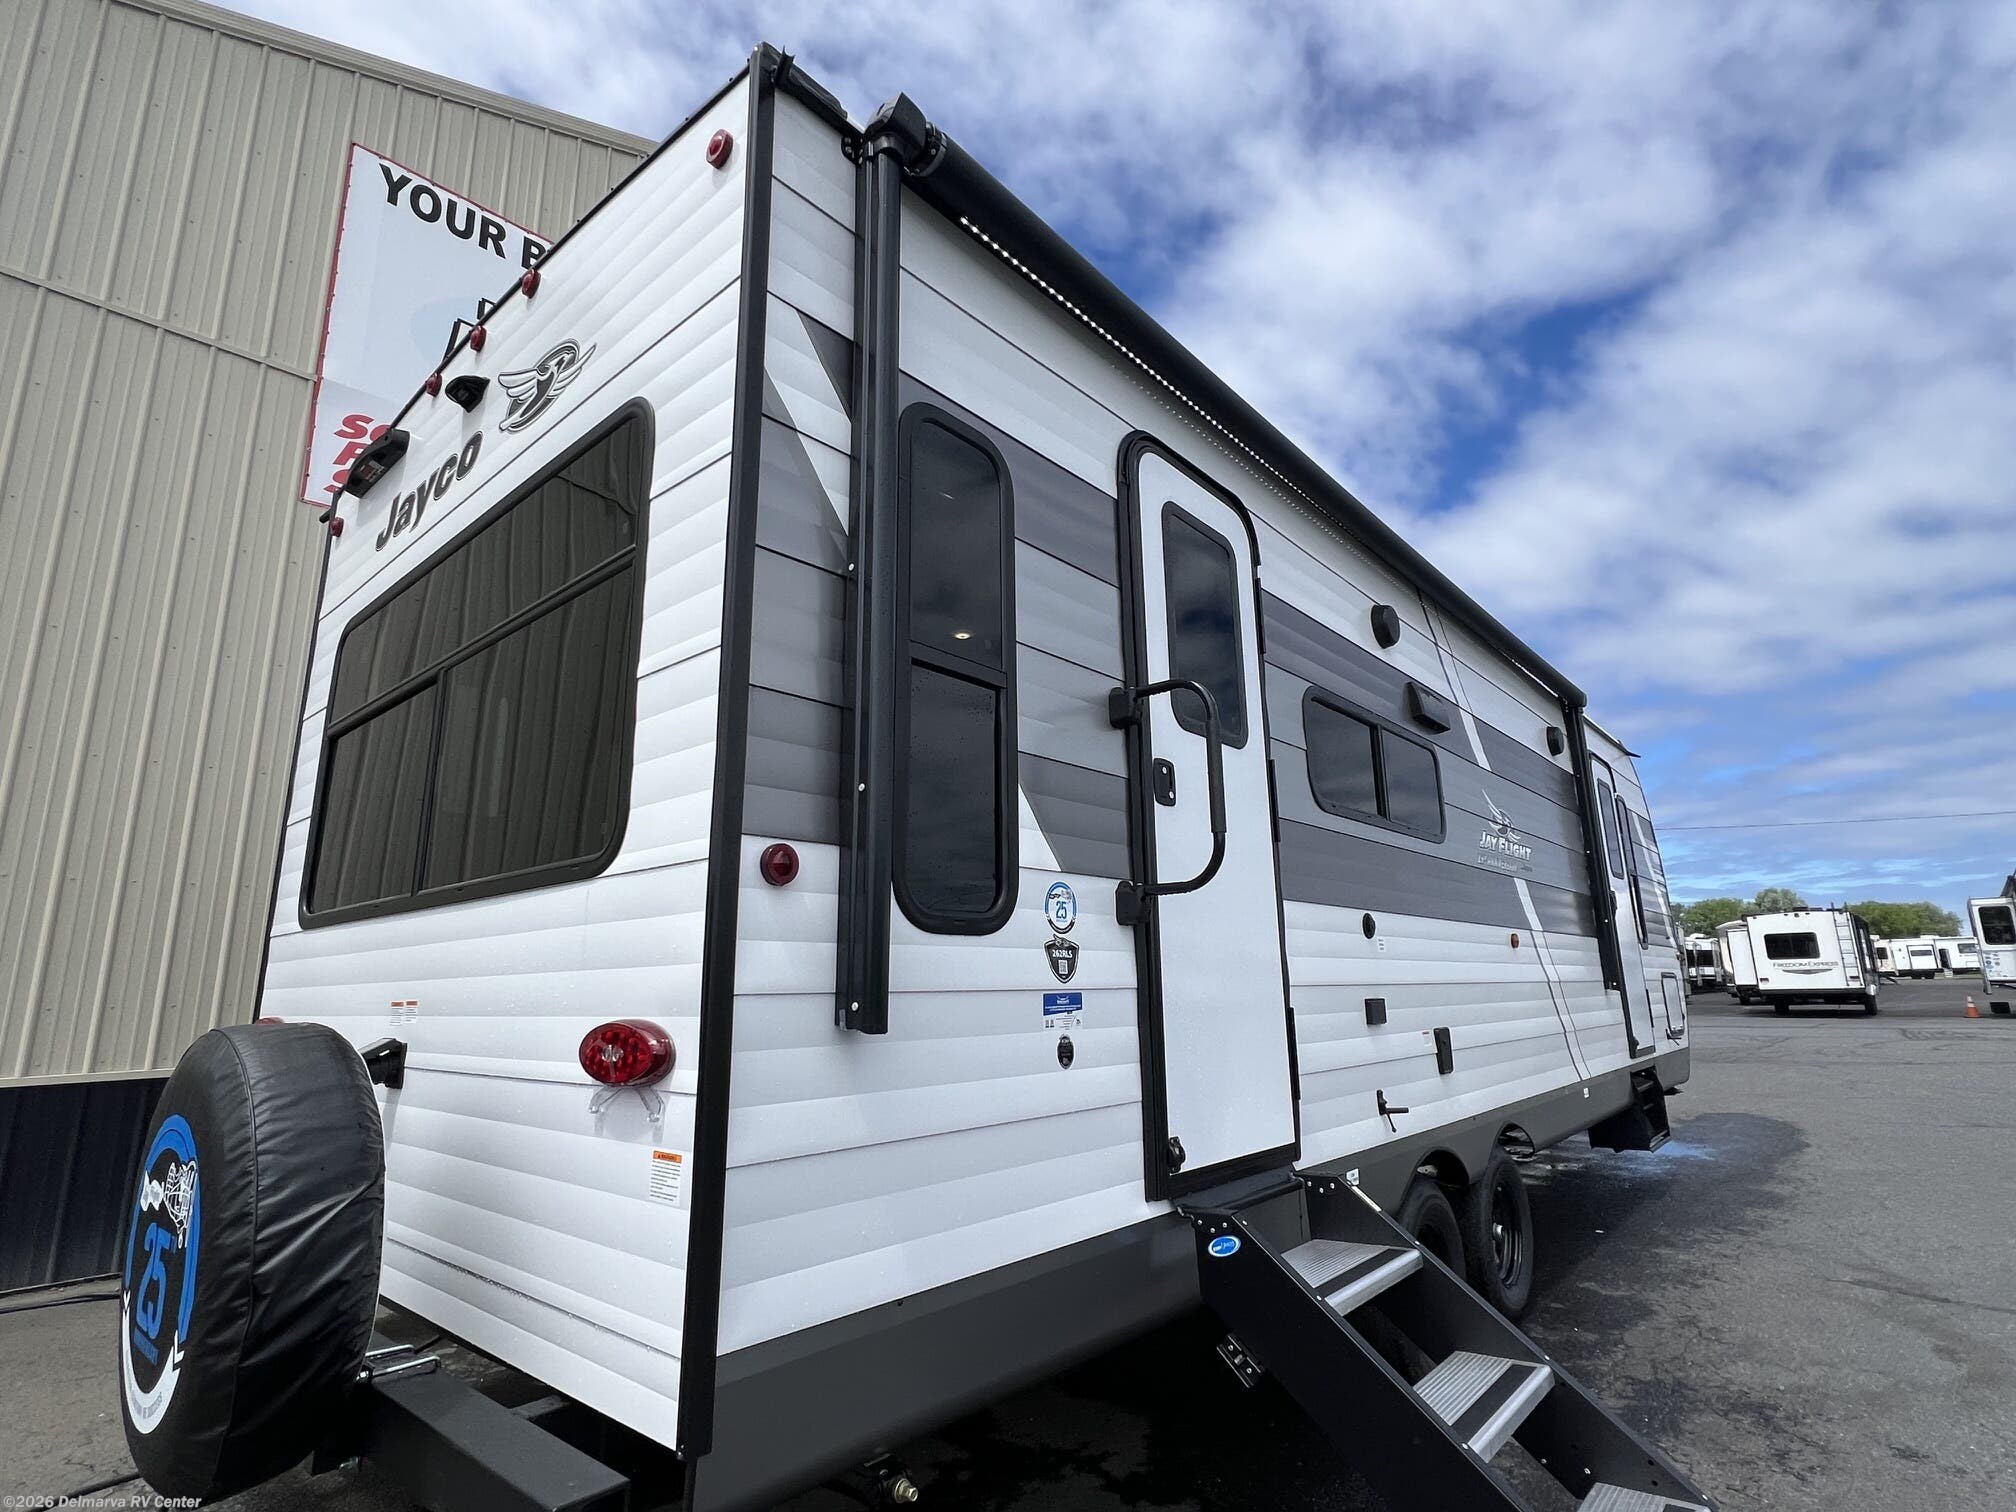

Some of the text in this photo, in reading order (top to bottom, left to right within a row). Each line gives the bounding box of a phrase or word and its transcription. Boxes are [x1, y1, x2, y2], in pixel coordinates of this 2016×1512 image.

[379, 163, 506, 259] YOUR
[376, 431, 483, 552] Jayco
[1479, 830, 1532, 861] JAY FLIGHT
[1056, 900, 1067, 919] 25
[136, 1222, 171, 1340] 25
